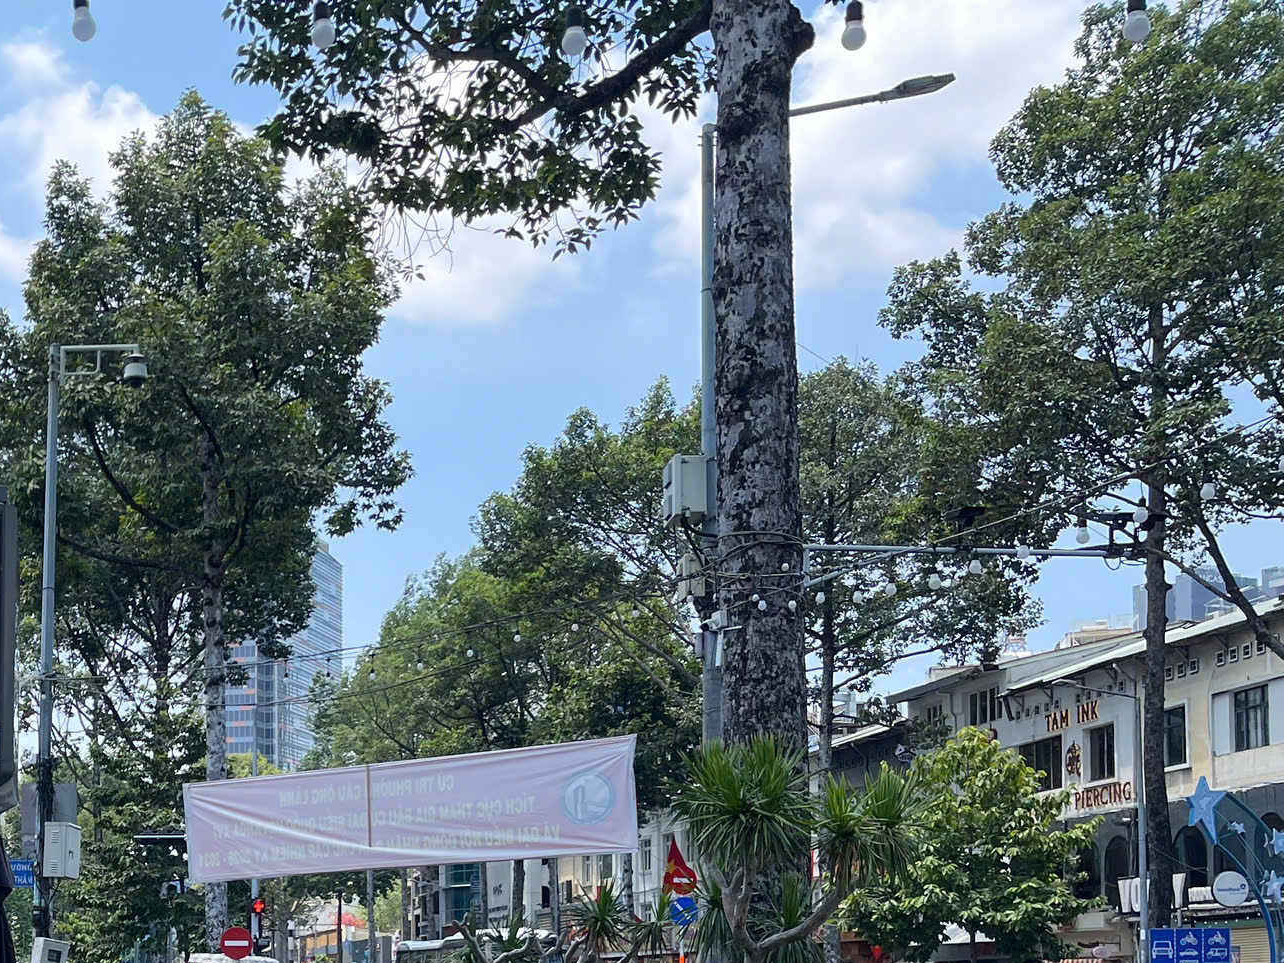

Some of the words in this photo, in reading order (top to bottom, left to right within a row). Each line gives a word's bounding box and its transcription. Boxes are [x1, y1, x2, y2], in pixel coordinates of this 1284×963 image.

[1045, 709, 1070, 732] TAM
[1077, 700, 1100, 724] INK
[1075, 782, 1131, 810] PIERCING
[10, 862, 33, 872] ƯỜNG
